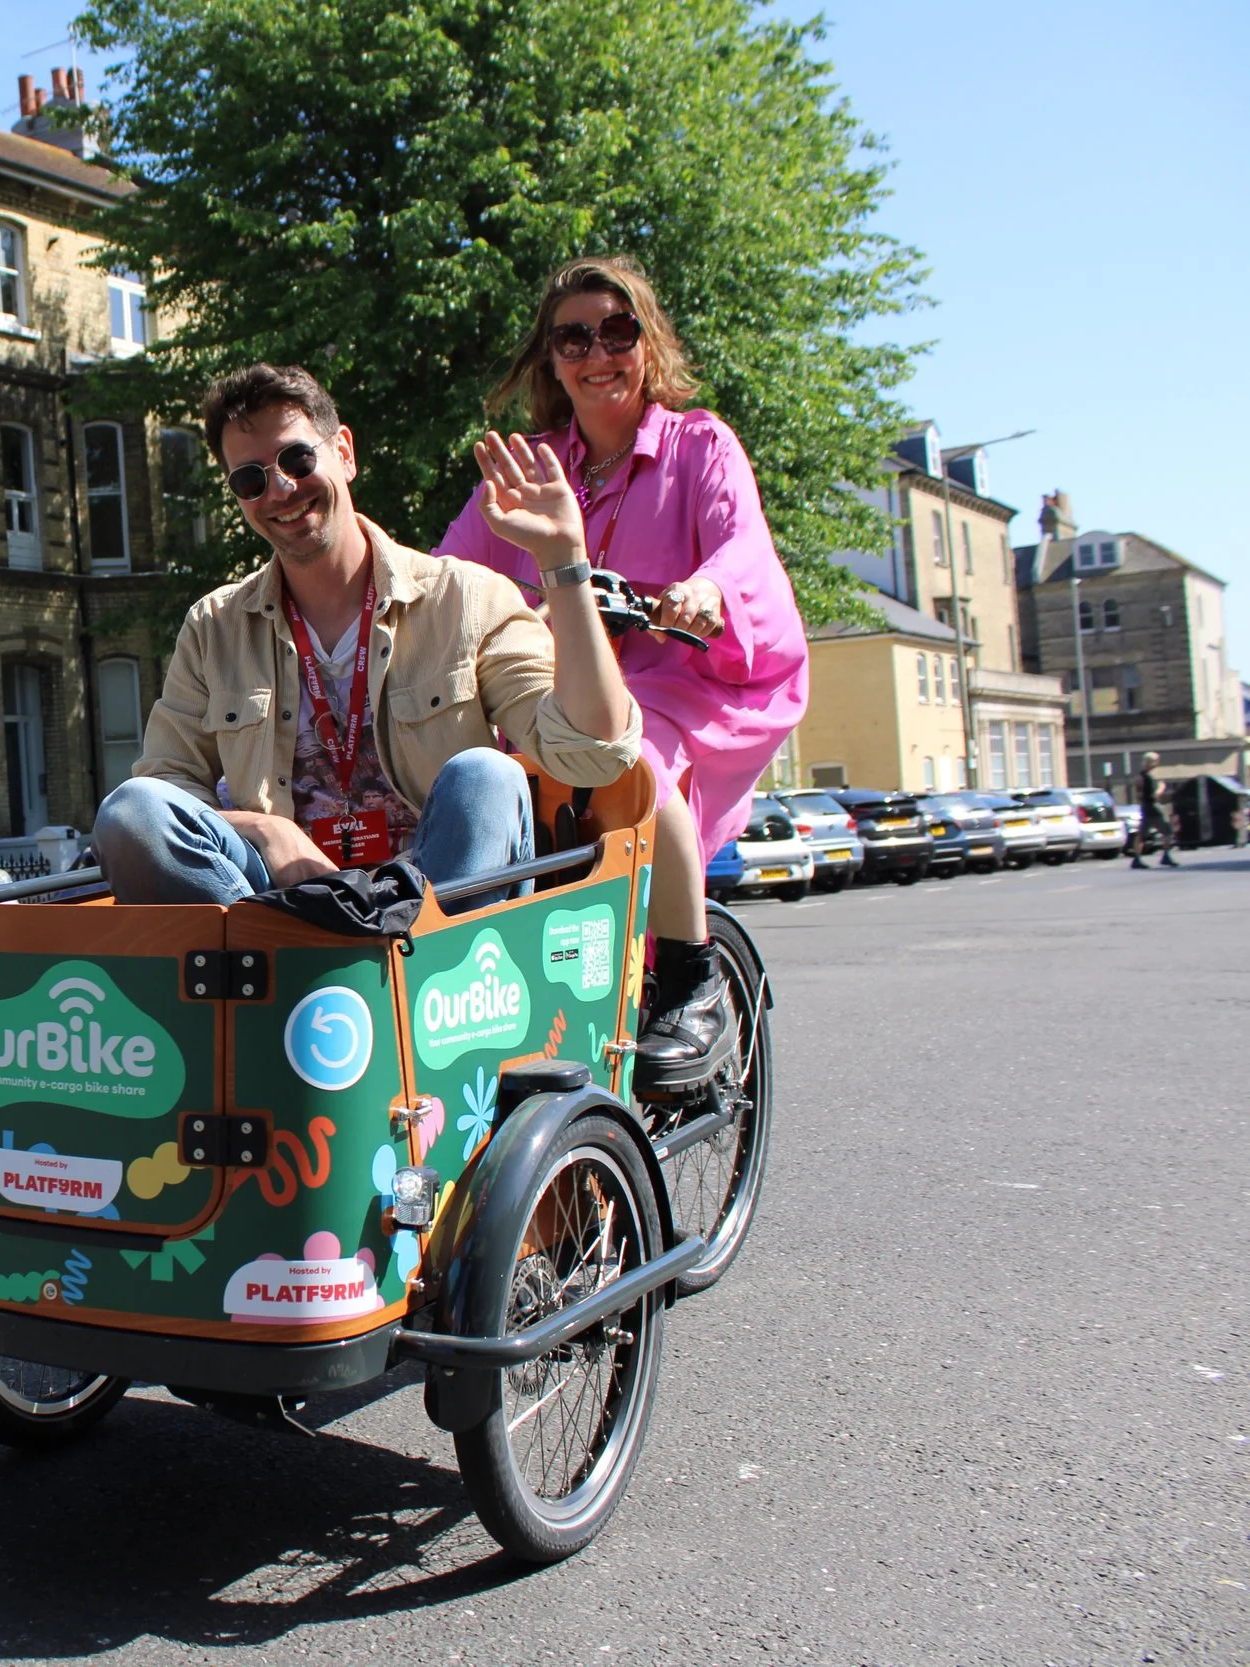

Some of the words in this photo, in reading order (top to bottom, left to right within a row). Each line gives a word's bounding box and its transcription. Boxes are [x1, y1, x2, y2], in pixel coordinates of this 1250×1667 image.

[357, 646, 367, 672] CREW
[423, 973, 521, 1032] OurBike
[39, 1081, 83, 1093] e-cargo
[85, 1081, 109, 1094] bike
[111, 1084, 146, 1096] share
[34, 1159, 58, 1168] Hosted
[59, 1160, 68, 1170] by
[3, 1172, 102, 1199] PLATF9RM
[289, 1266, 320, 1275] Hosted
[321, 1266, 331, 1275] by
[246, 1280, 365, 1303] PLATF9RM
